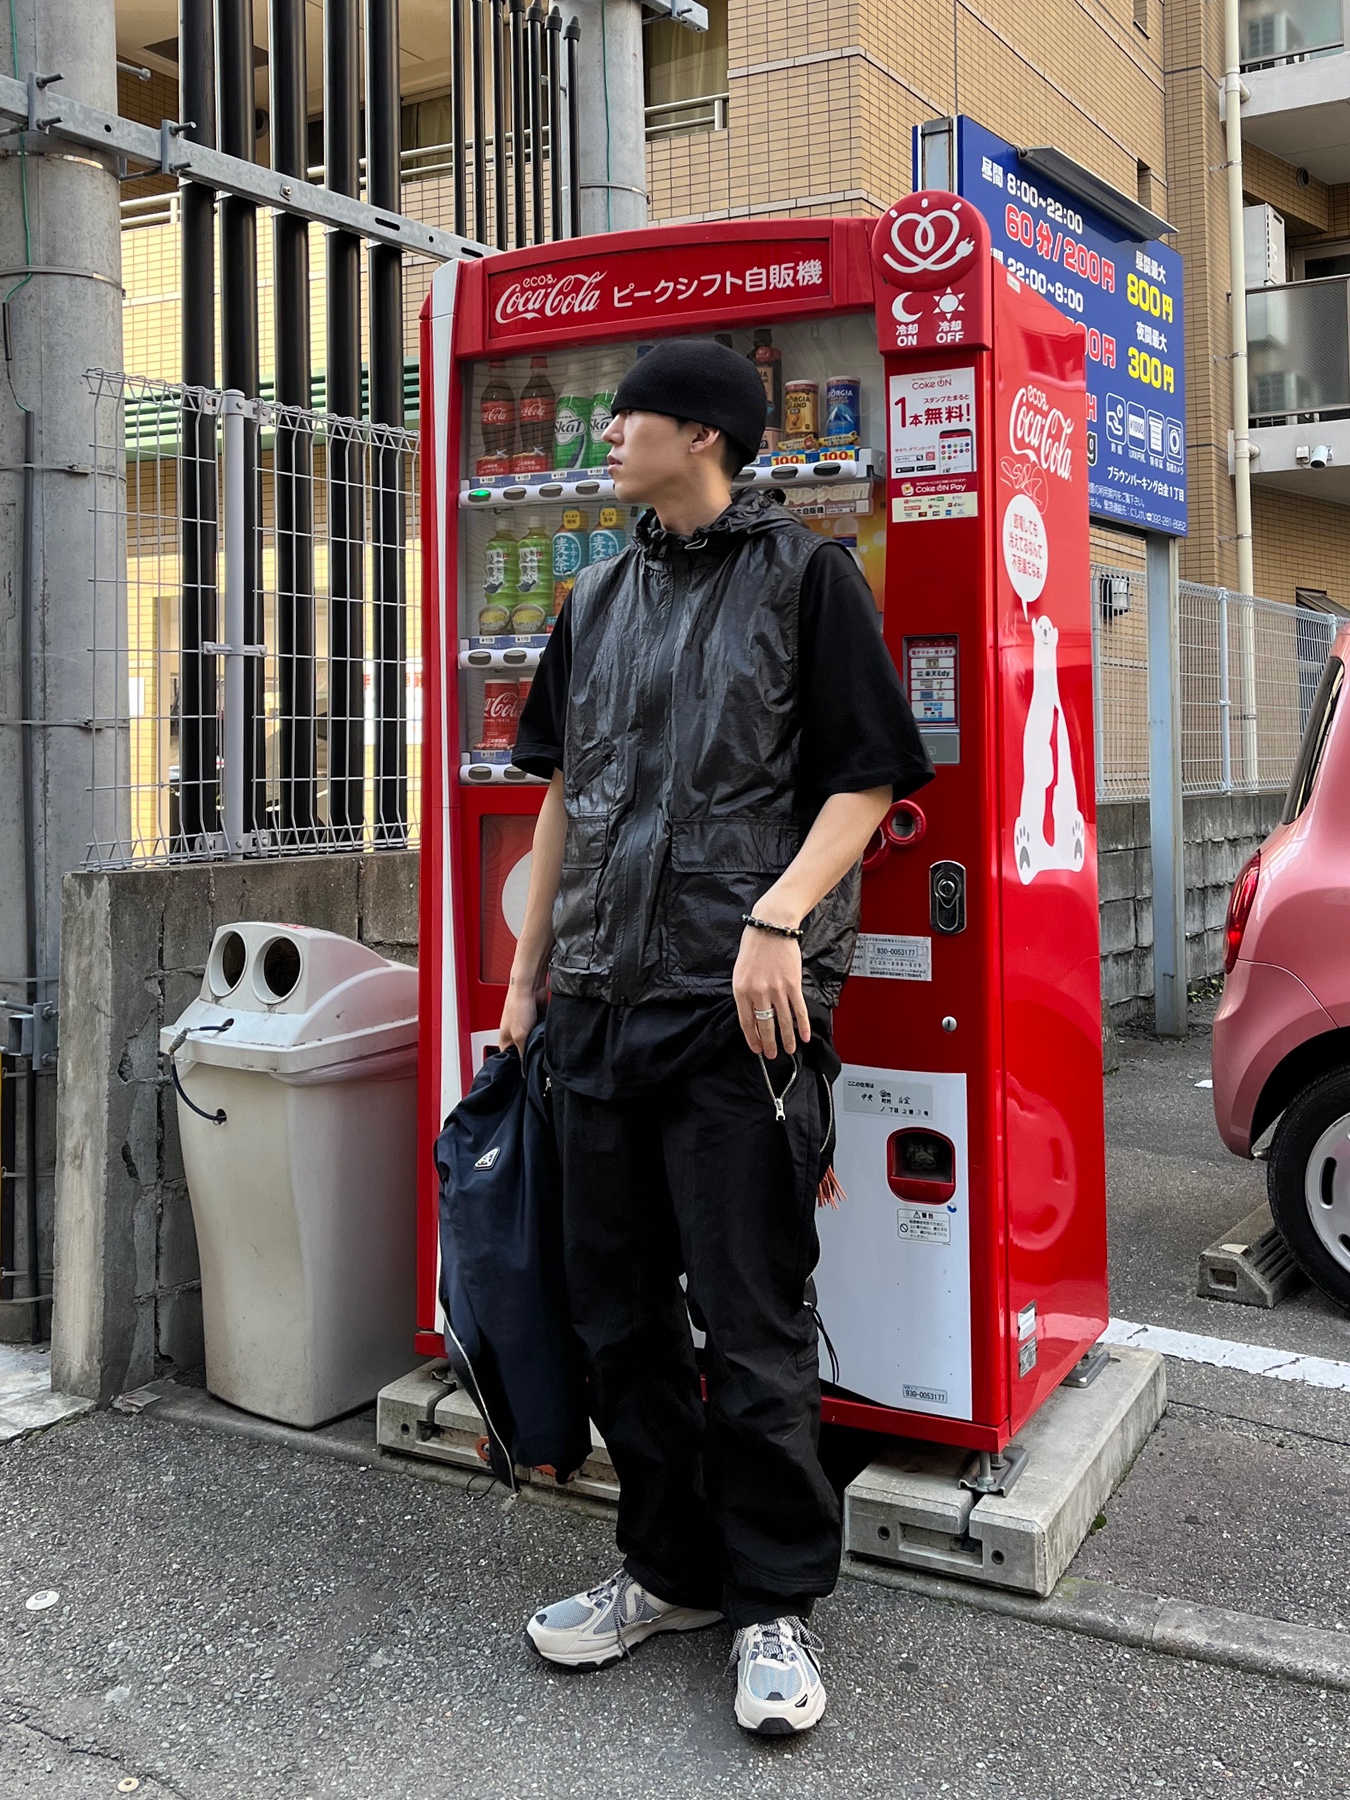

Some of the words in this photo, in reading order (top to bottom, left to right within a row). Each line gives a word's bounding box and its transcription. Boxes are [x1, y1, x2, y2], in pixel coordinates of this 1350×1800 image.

[982, 156, 1003, 188] 昼間
[1005, 203, 1115, 294] 60分/200円
[1136, 250, 1166, 285] 昼間最大
[614, 259, 822, 308] ピークシフト自販機
[495, 270, 608, 324] Coca-Cola
[1127, 273, 1173, 324] 800円
[895, 324, 919, 336] 冷却
[938, 320, 962, 332] 冷却
[897, 335, 917, 347] ON
[936, 331, 964, 343] OFF
[1136, 321, 1167, 354] 夜間最大
[1127, 346, 1174, 394] 300円
[911, 381, 935, 391] Coke
[937, 378, 952, 388] ON
[924, 394, 970, 404] スタンプたまると
[1009, 387, 1074, 481] Coca-Cola
[772, 456, 804, 465] 100円
[821, 450, 854, 461] 100円
[915, 485, 936, 493] Coke
[937, 484, 949, 492] ON
[950, 483, 967, 493] Pay
[1107, 466, 1185, 502] ブラウンパーキング白金1丁目
[555, 537, 569, 572] 麦茶
[877, 947, 915, 956] 930-0053177
[861, 1093, 873, 1102] 中央
[905, 1389, 945, 1401] 930-0053177
